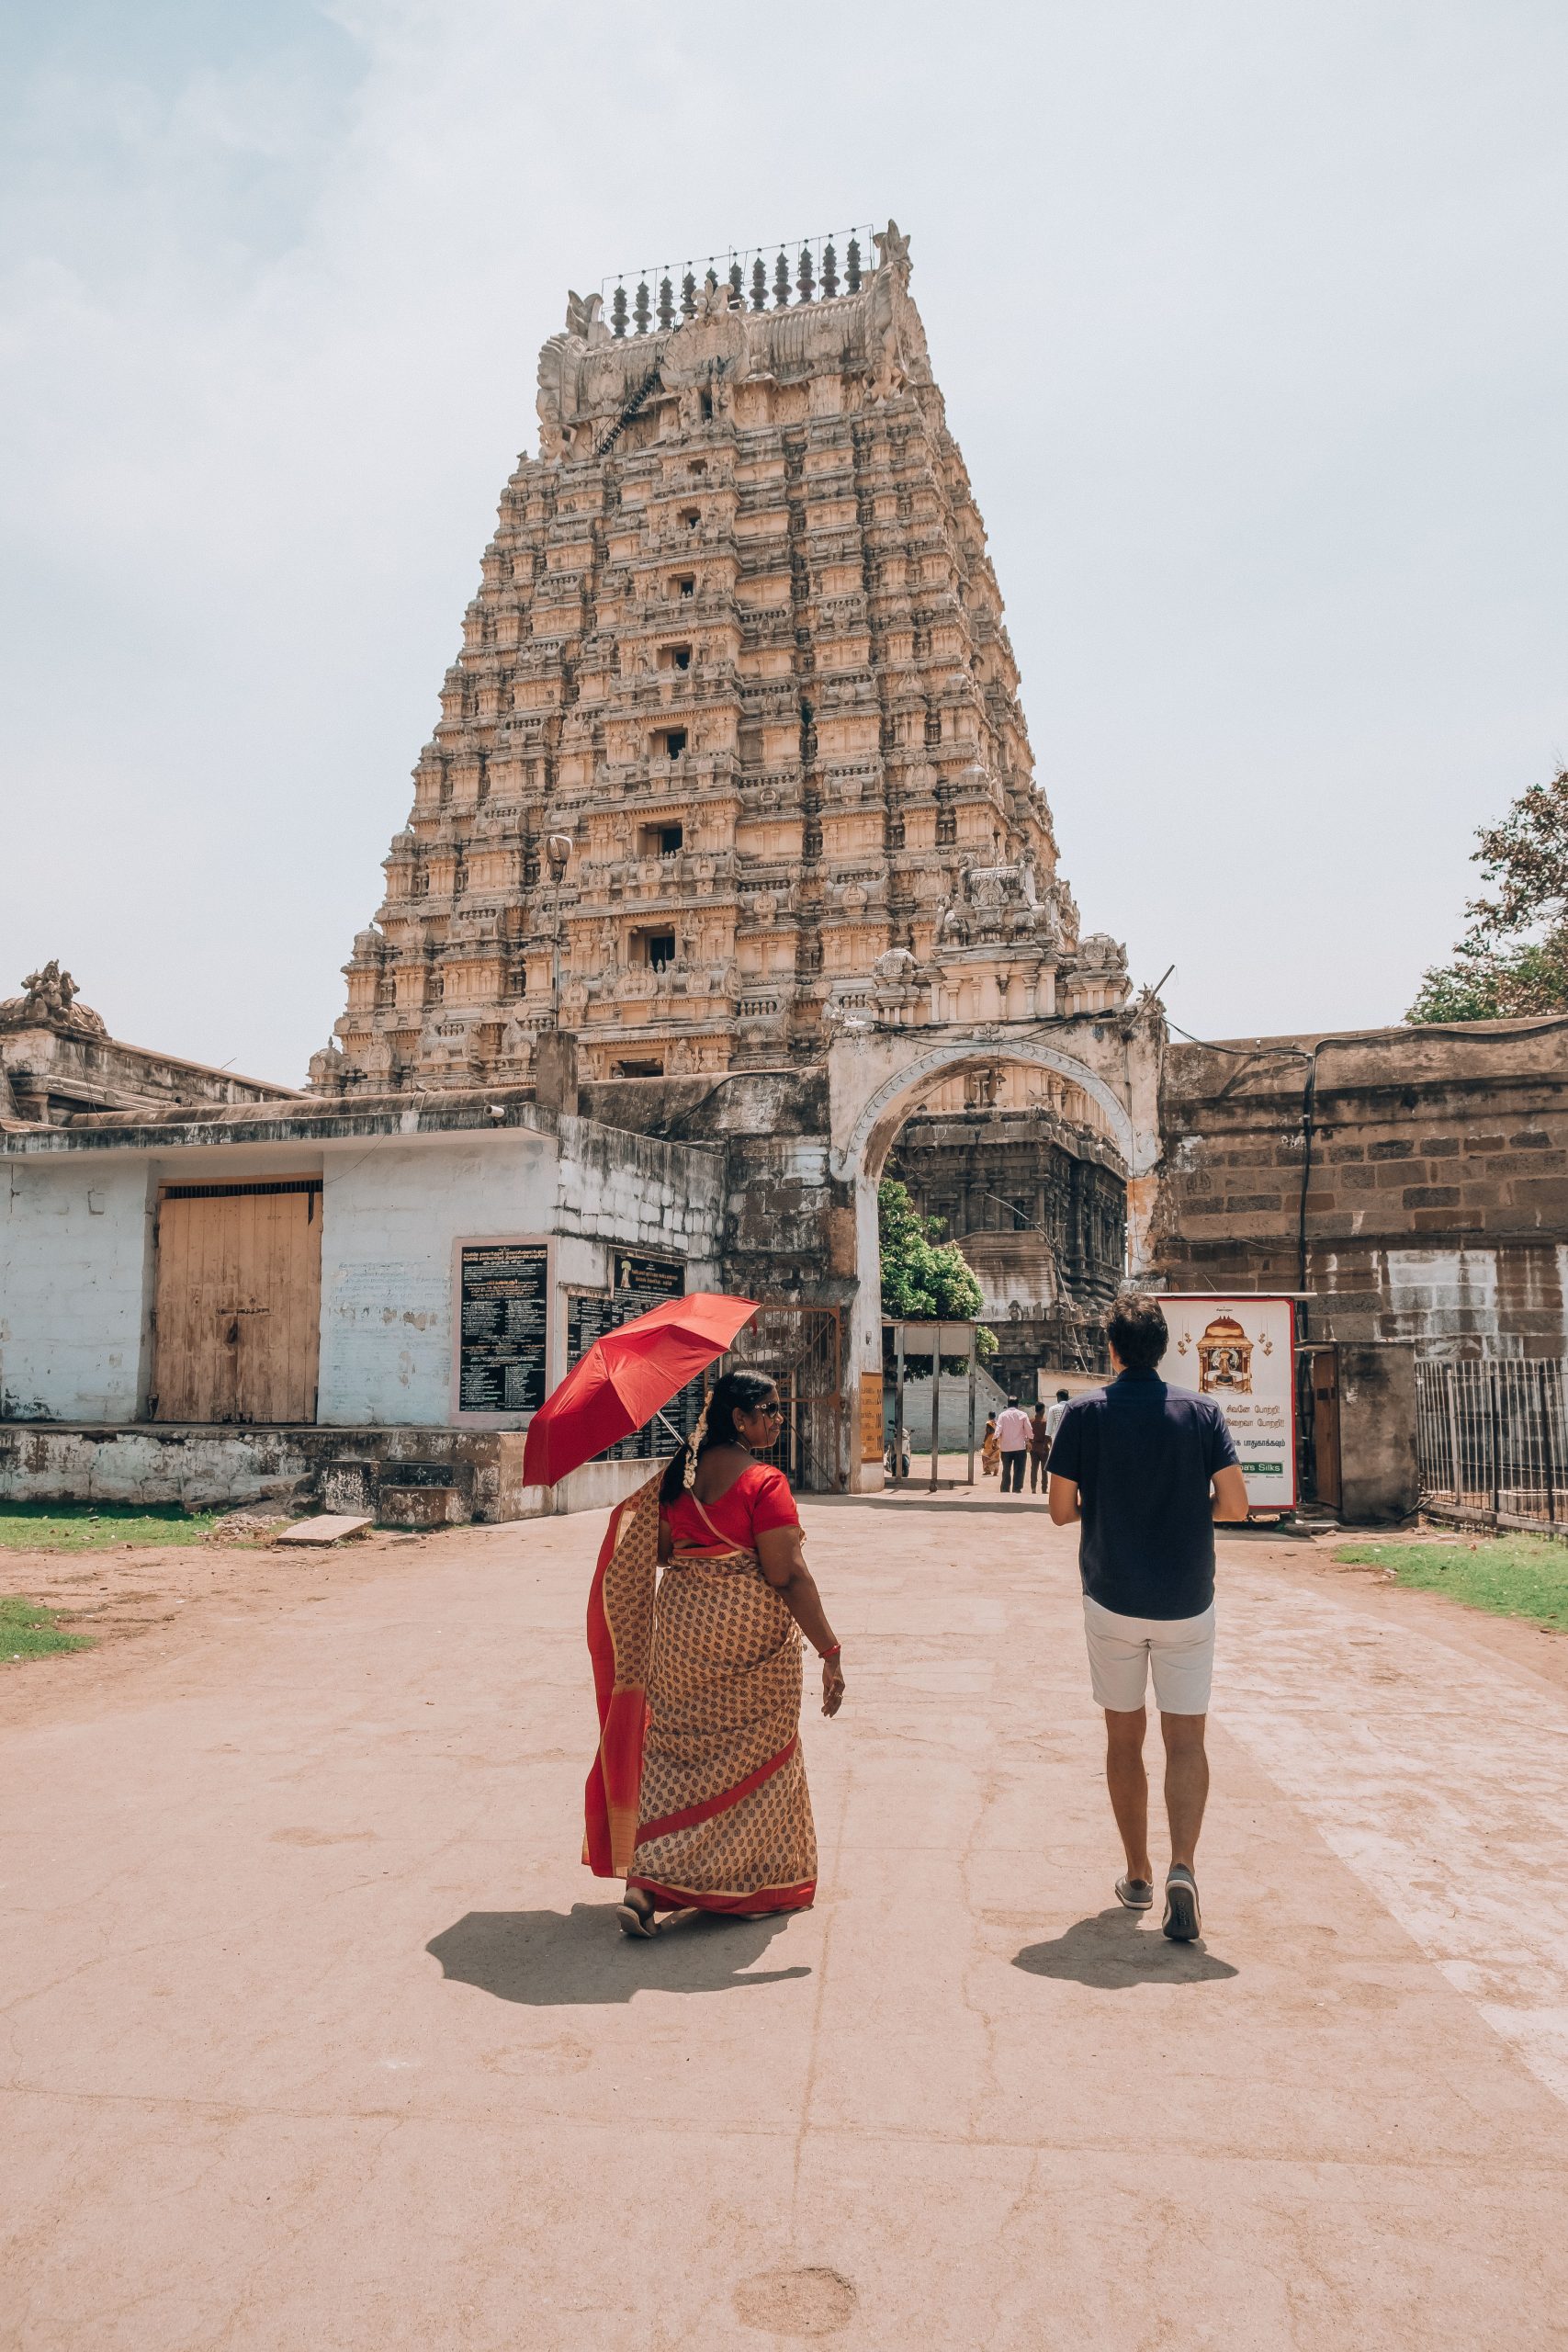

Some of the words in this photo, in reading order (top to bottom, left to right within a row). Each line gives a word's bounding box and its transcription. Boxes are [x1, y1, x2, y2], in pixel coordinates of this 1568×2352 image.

[1226, 1405, 1250, 1413] சிவனே
[1243, 1438, 1286, 1449] பாதுகாக்கவும்
[1258, 1464, 1280, 1472] Silks
